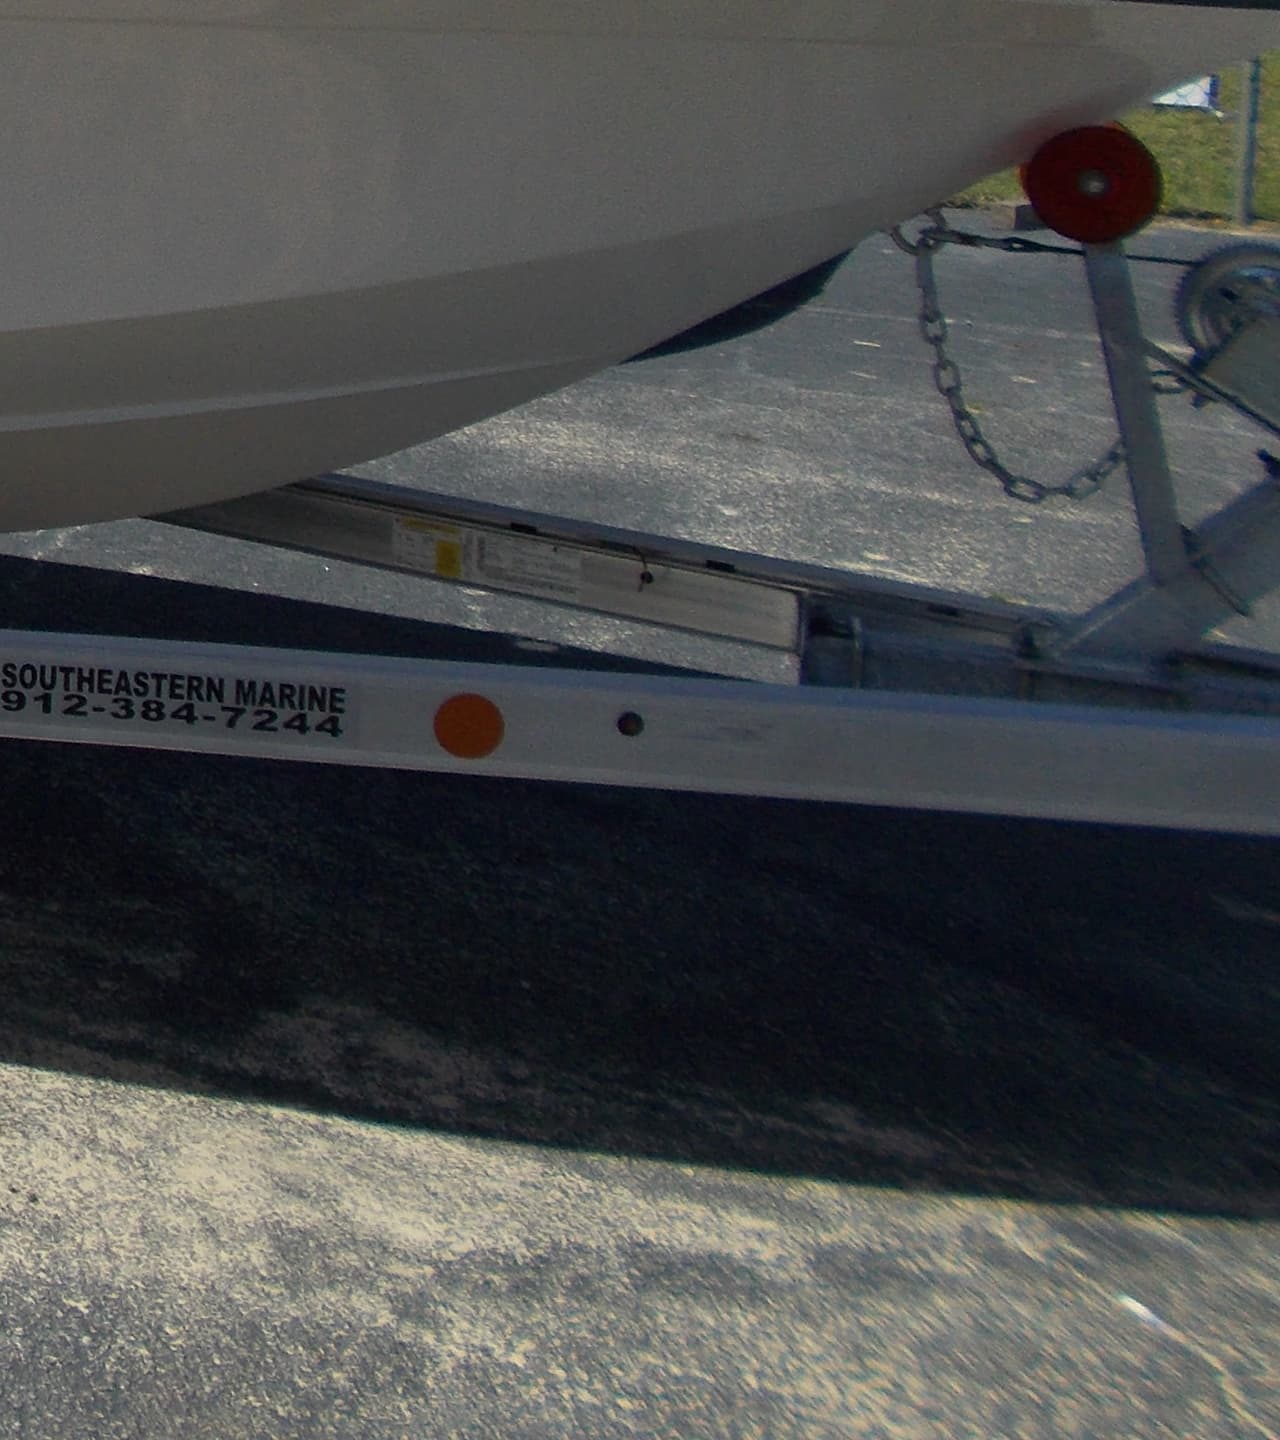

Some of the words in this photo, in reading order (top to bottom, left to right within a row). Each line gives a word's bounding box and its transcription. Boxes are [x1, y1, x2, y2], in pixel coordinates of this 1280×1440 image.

[1, 662, 226, 703] SOUTHEASTERN
[235, 679, 346, 715] MARINE
[0, 690, 344, 738] 912-384-7244
